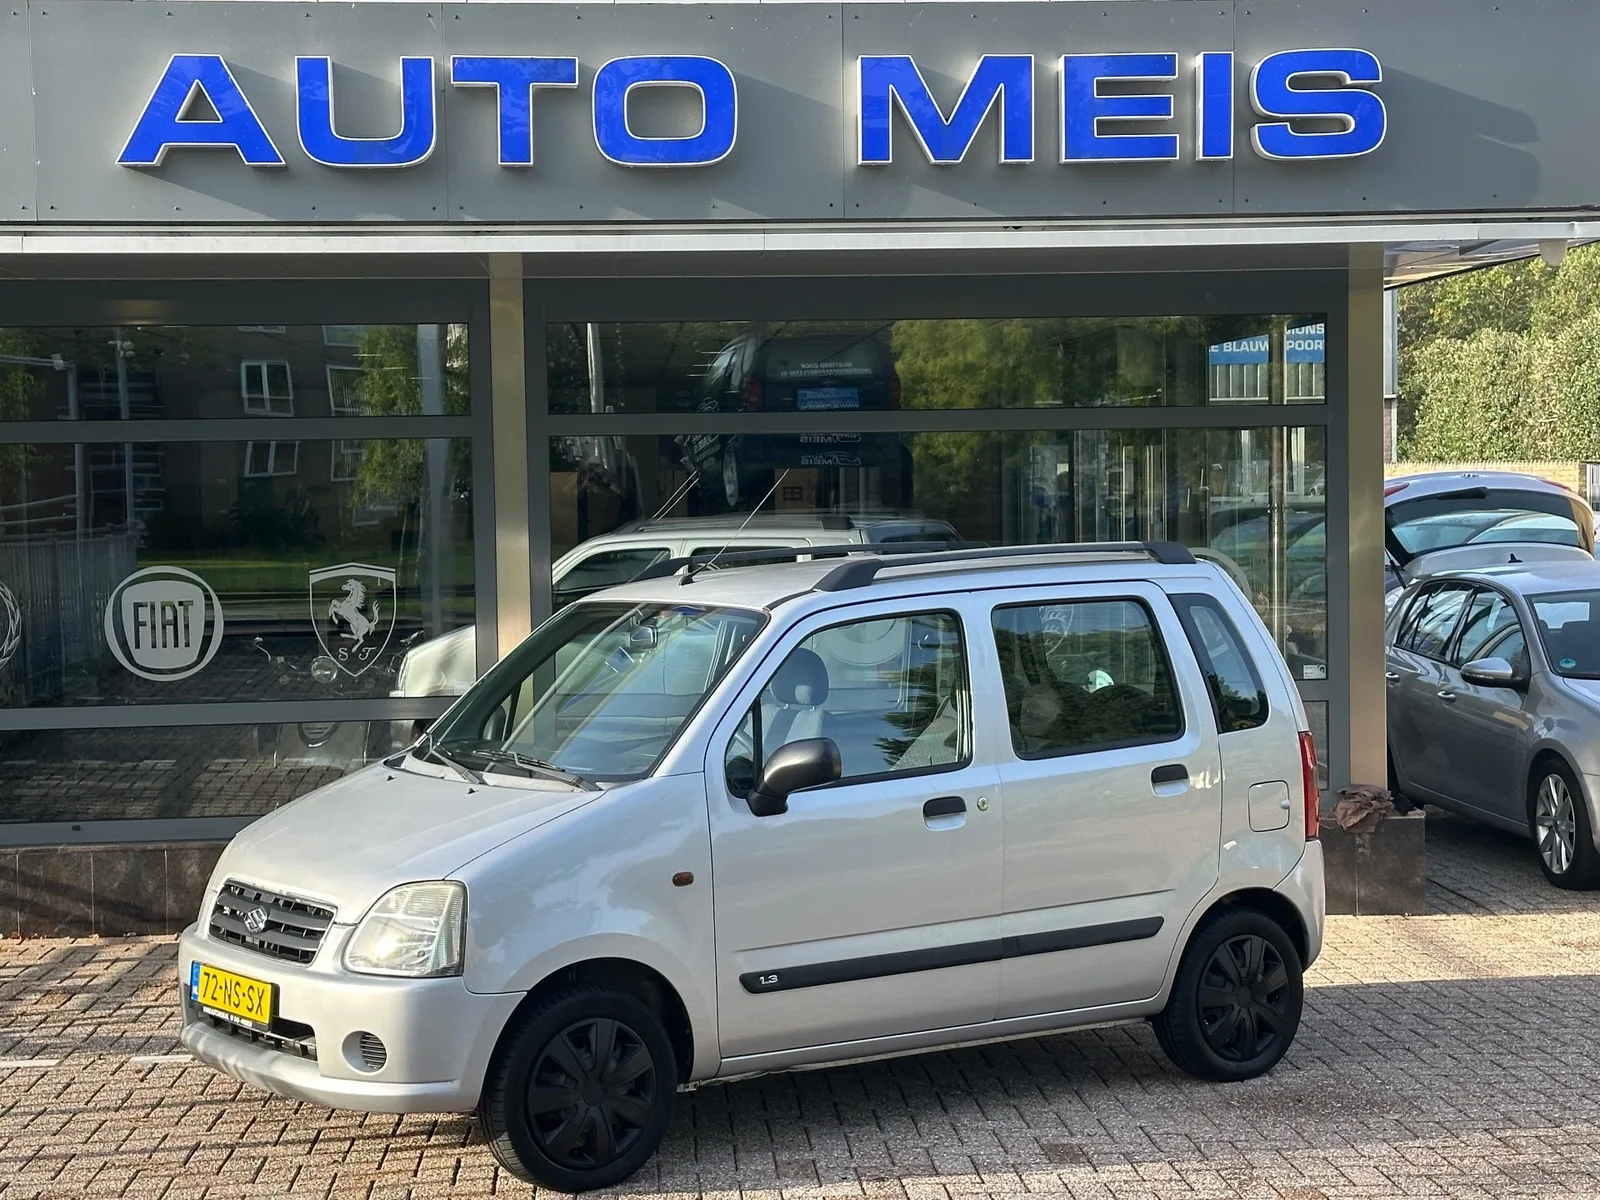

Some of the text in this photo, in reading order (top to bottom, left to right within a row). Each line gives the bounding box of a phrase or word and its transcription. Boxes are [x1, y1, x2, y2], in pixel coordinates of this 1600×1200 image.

[115, 47, 1388, 168] AUTO MEIS
[1223, 341, 1269, 352] BLAUW
[1286, 339, 1325, 351] POOR
[133, 600, 194, 649] FIAT
[338, 647, 349, 661] S
[202, 972, 265, 1016] 72-NS-SX
[759, 974, 778, 985] 1.3
